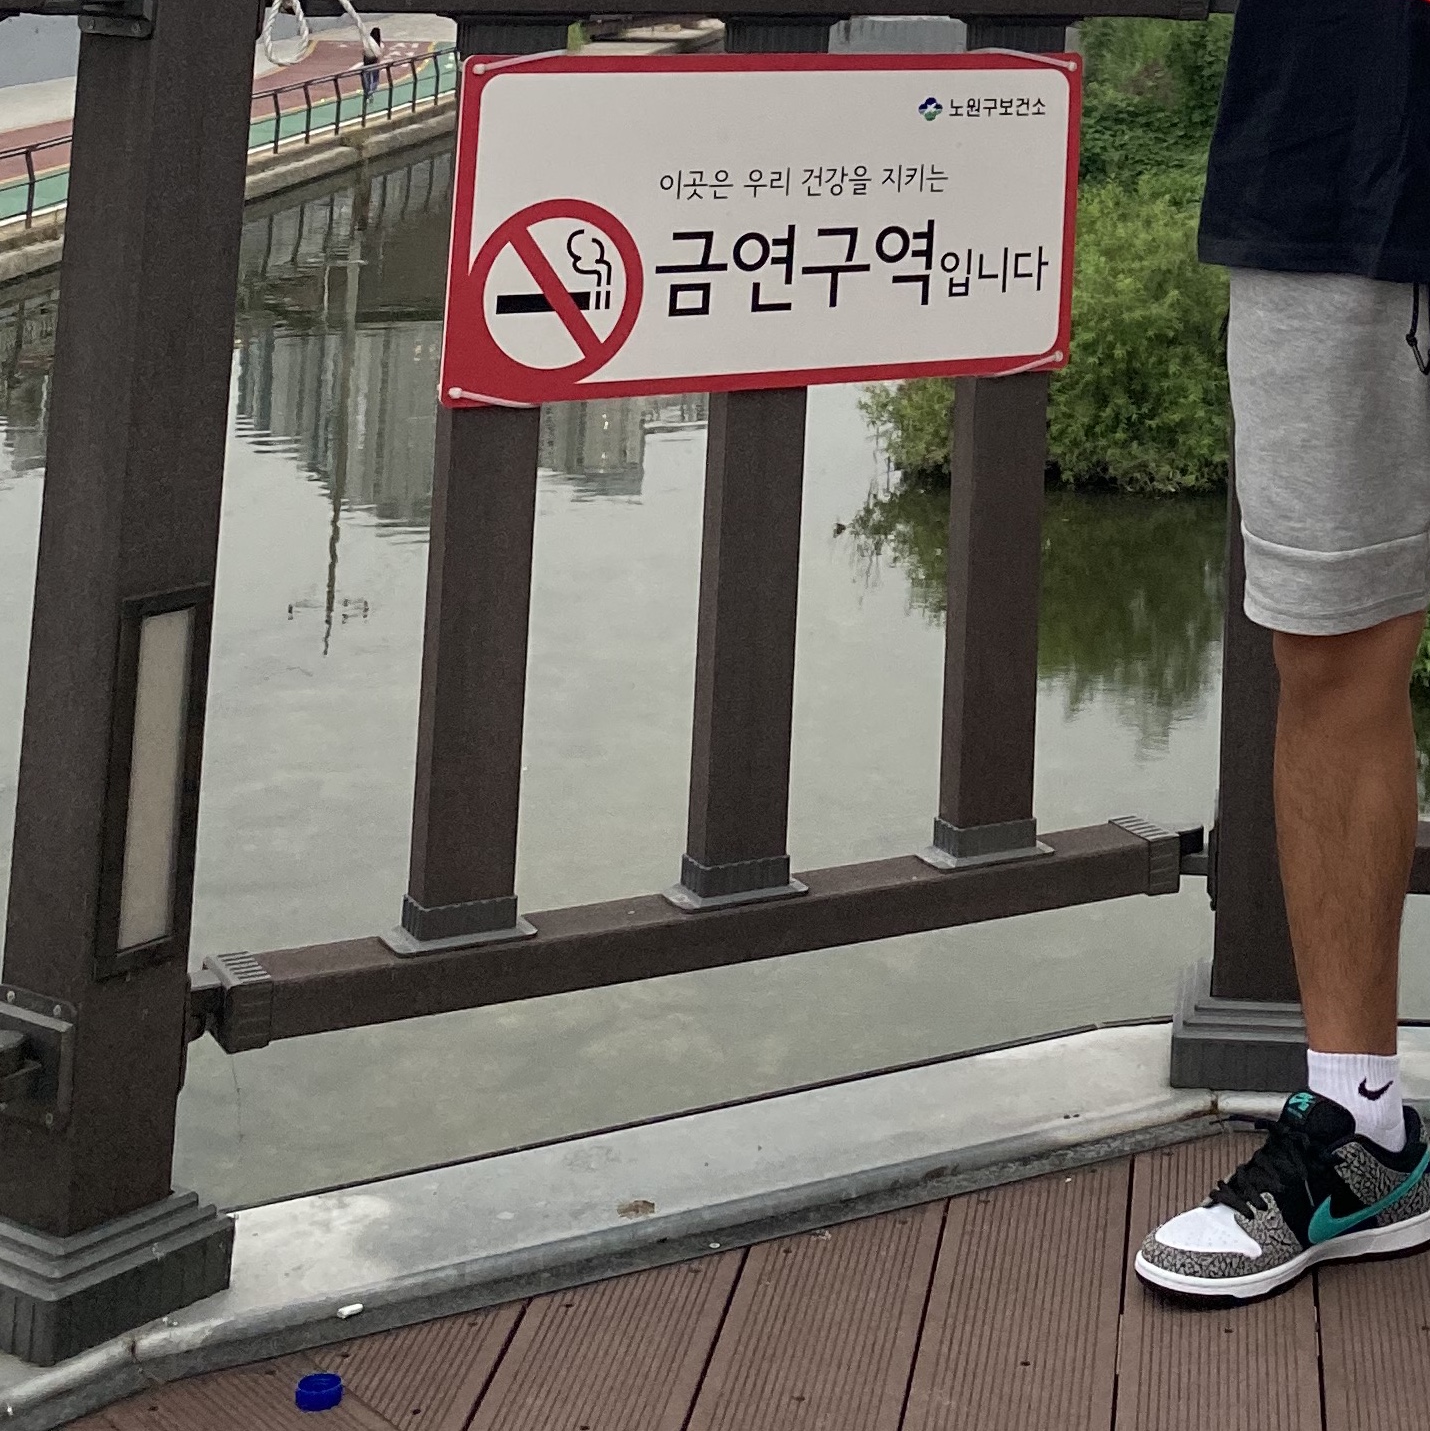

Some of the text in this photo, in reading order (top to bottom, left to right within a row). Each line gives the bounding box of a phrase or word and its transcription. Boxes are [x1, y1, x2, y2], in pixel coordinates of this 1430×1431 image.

[948, 96, 1047, 118] 노원구보건소
[659, 163, 949, 201] 이곳은 우리 건강을 지키는
